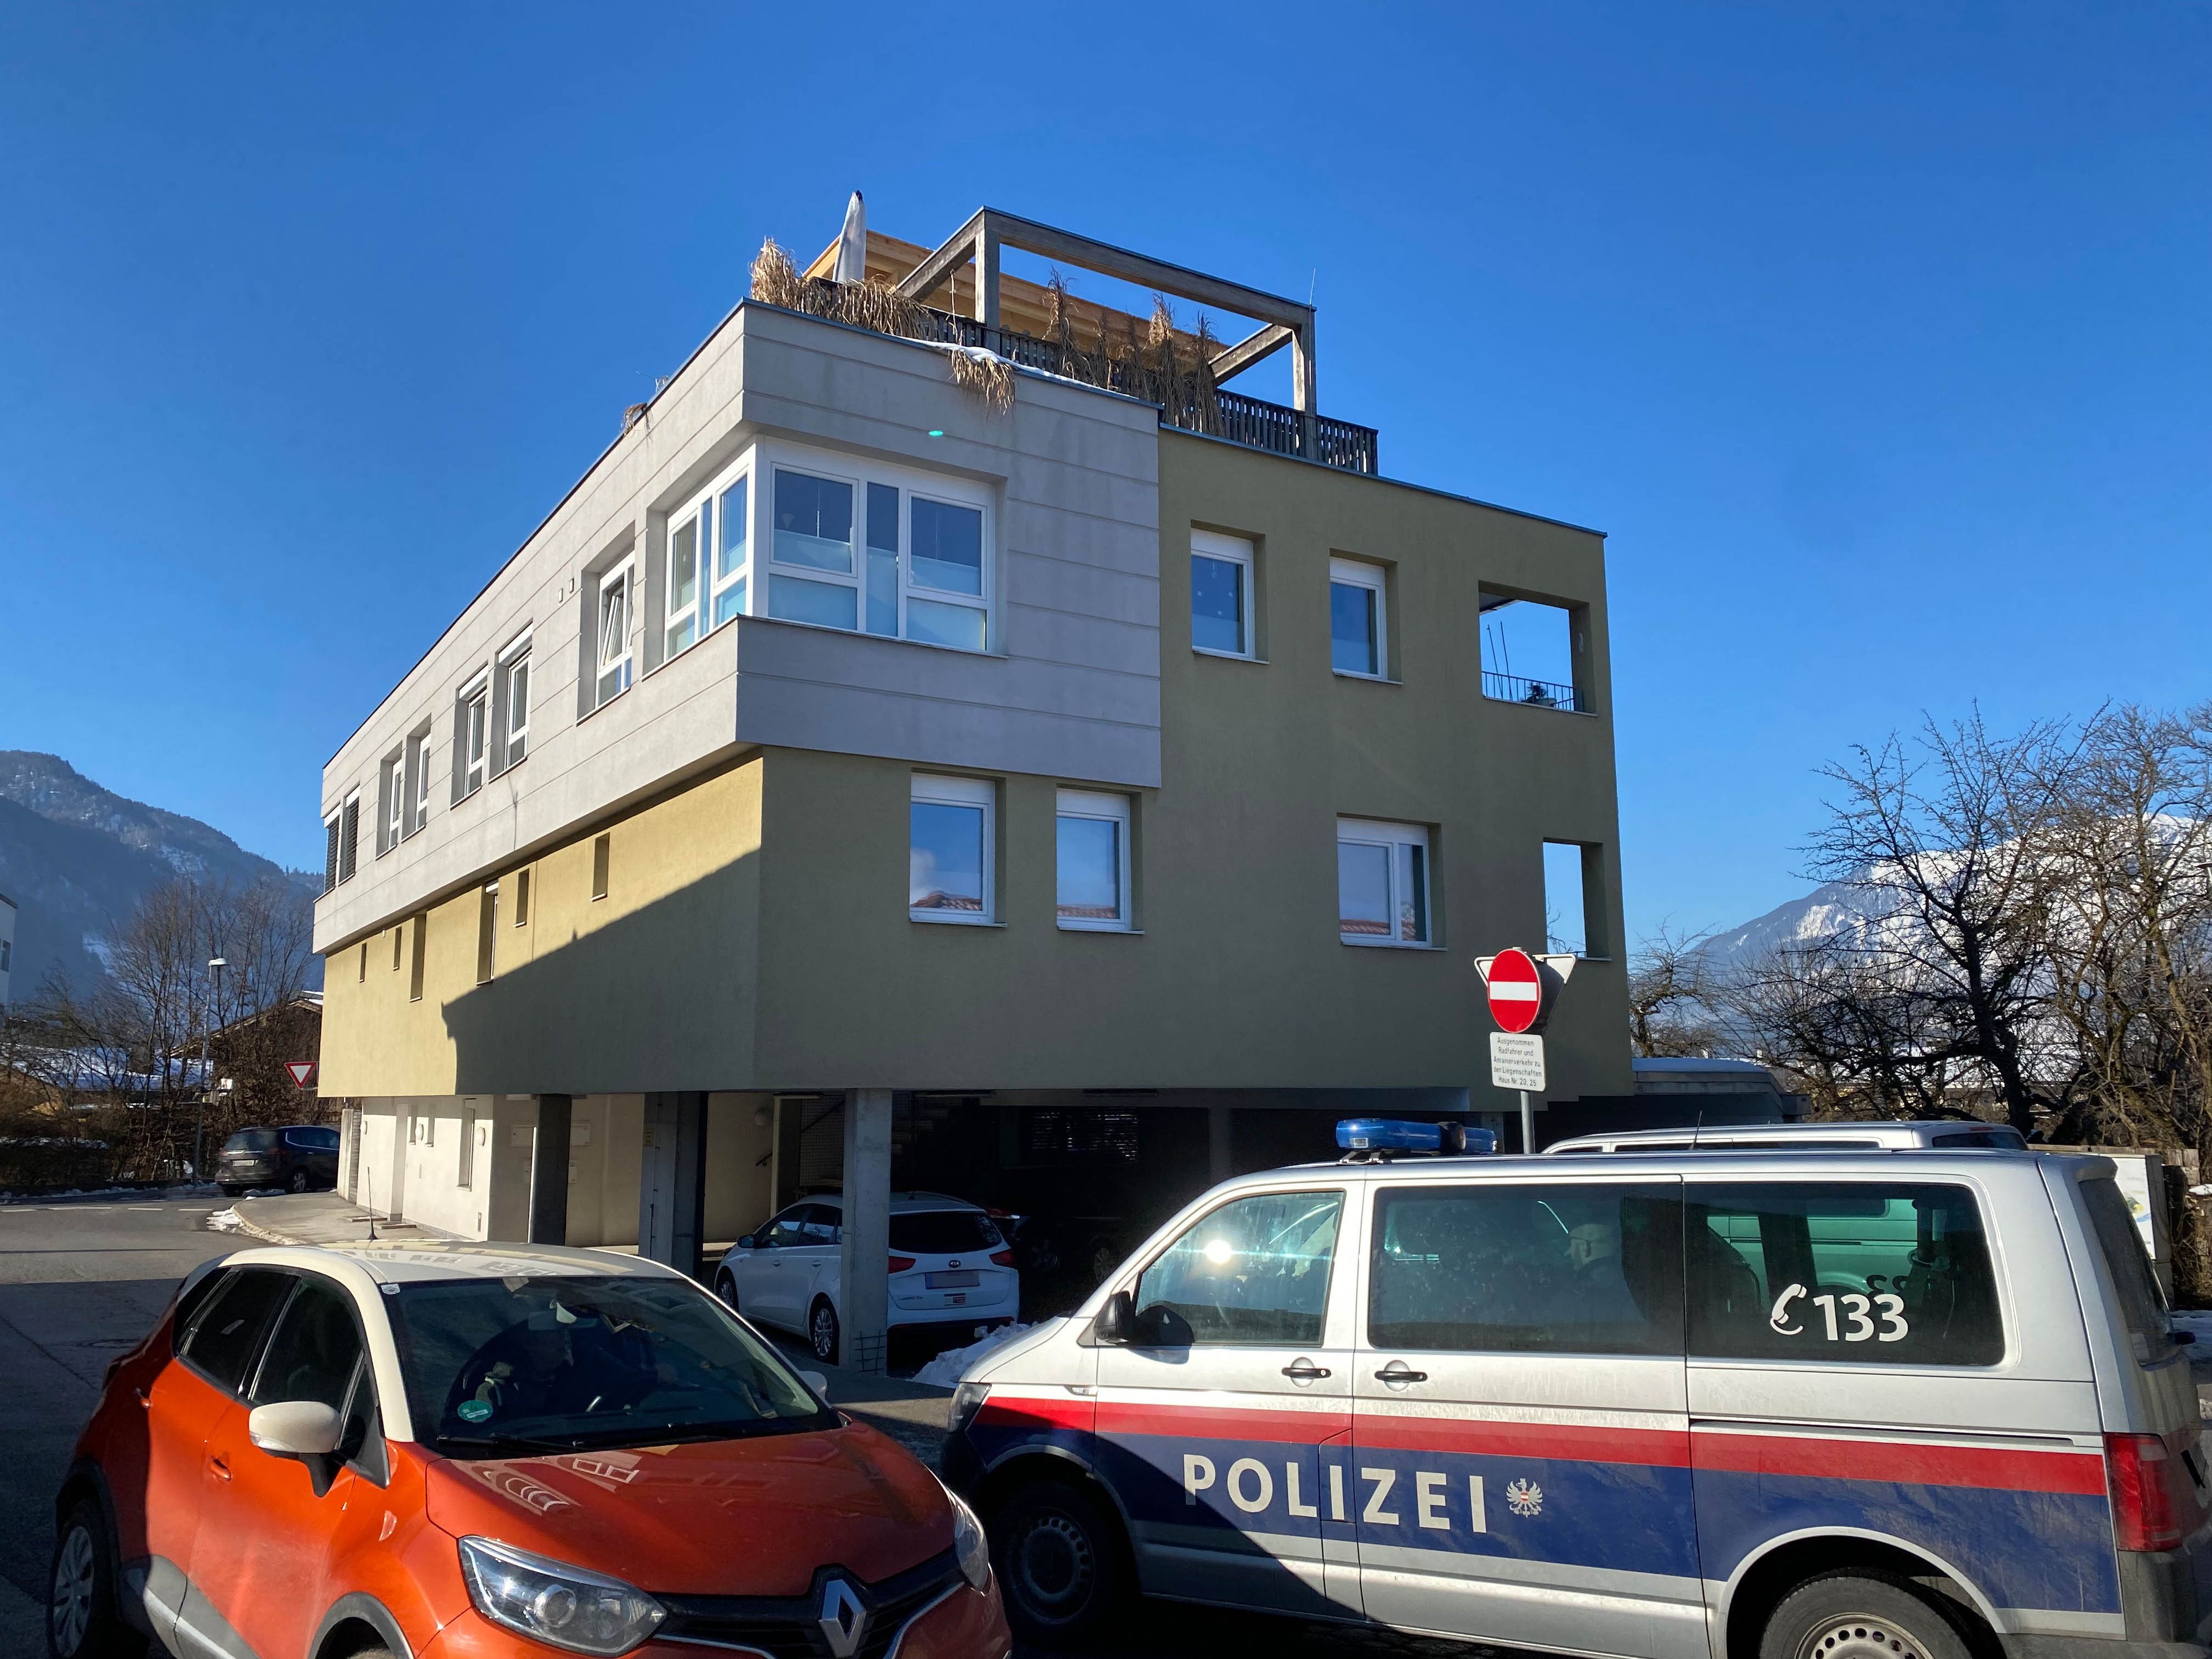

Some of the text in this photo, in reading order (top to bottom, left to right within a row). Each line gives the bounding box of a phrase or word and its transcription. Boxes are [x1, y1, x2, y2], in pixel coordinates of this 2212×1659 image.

[1497, 1037, 1534, 1046] Ausgenommen
[1498, 1046, 1522, 1055] Radfahrer
[1502, 1066, 1542, 1077] Liegenschaften
[1498, 1076, 1510, 1084] Haus
[1813, 1293, 1909, 1342] 133
[1182, 1454, 1487, 1533] POLIZEI
